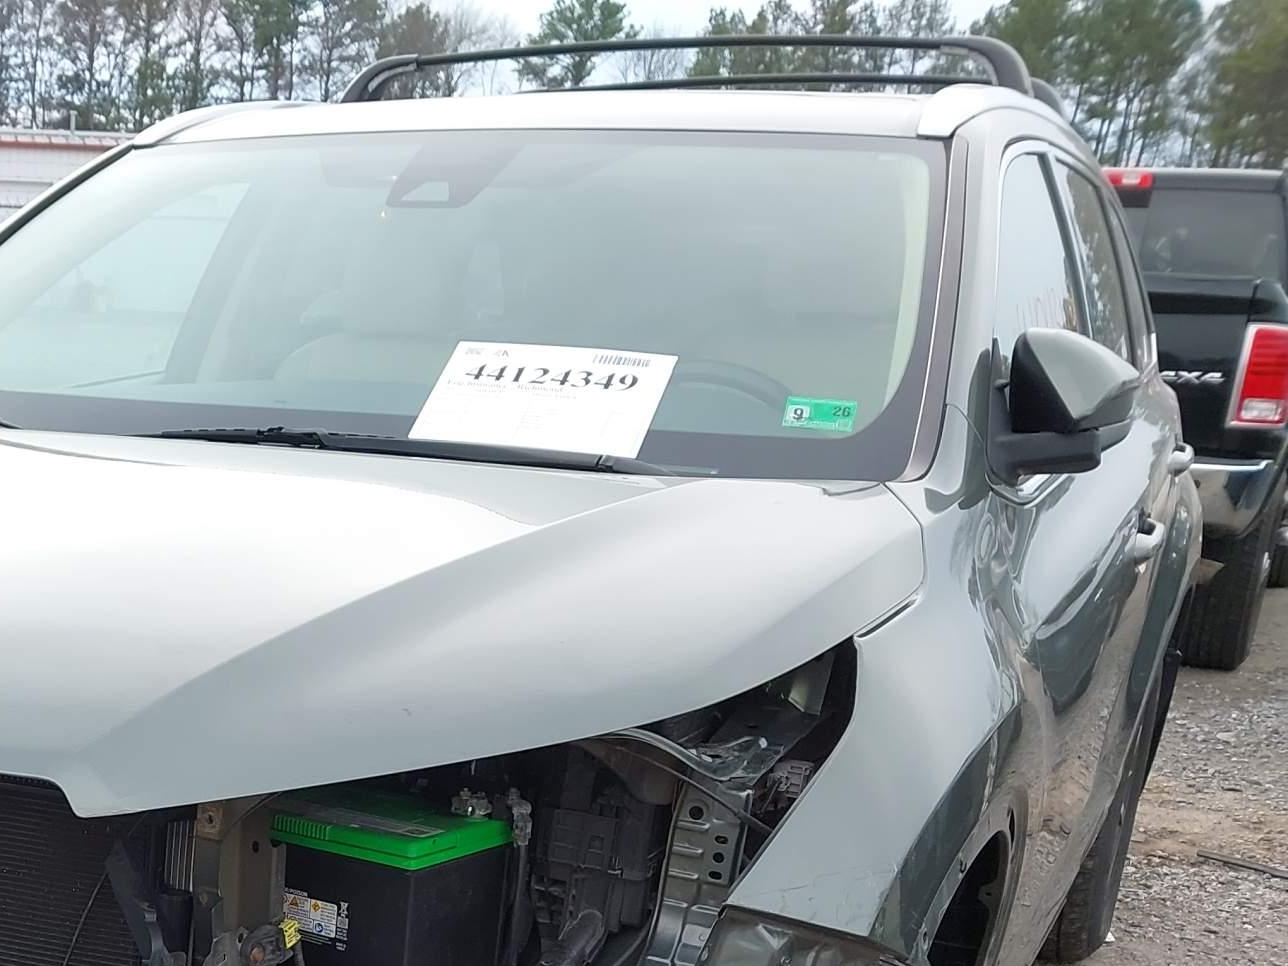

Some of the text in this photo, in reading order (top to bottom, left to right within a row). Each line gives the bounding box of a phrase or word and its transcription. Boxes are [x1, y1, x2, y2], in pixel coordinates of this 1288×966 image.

[465, 364, 639, 391] 44124349
[792, 406, 851, 420] 9 26
